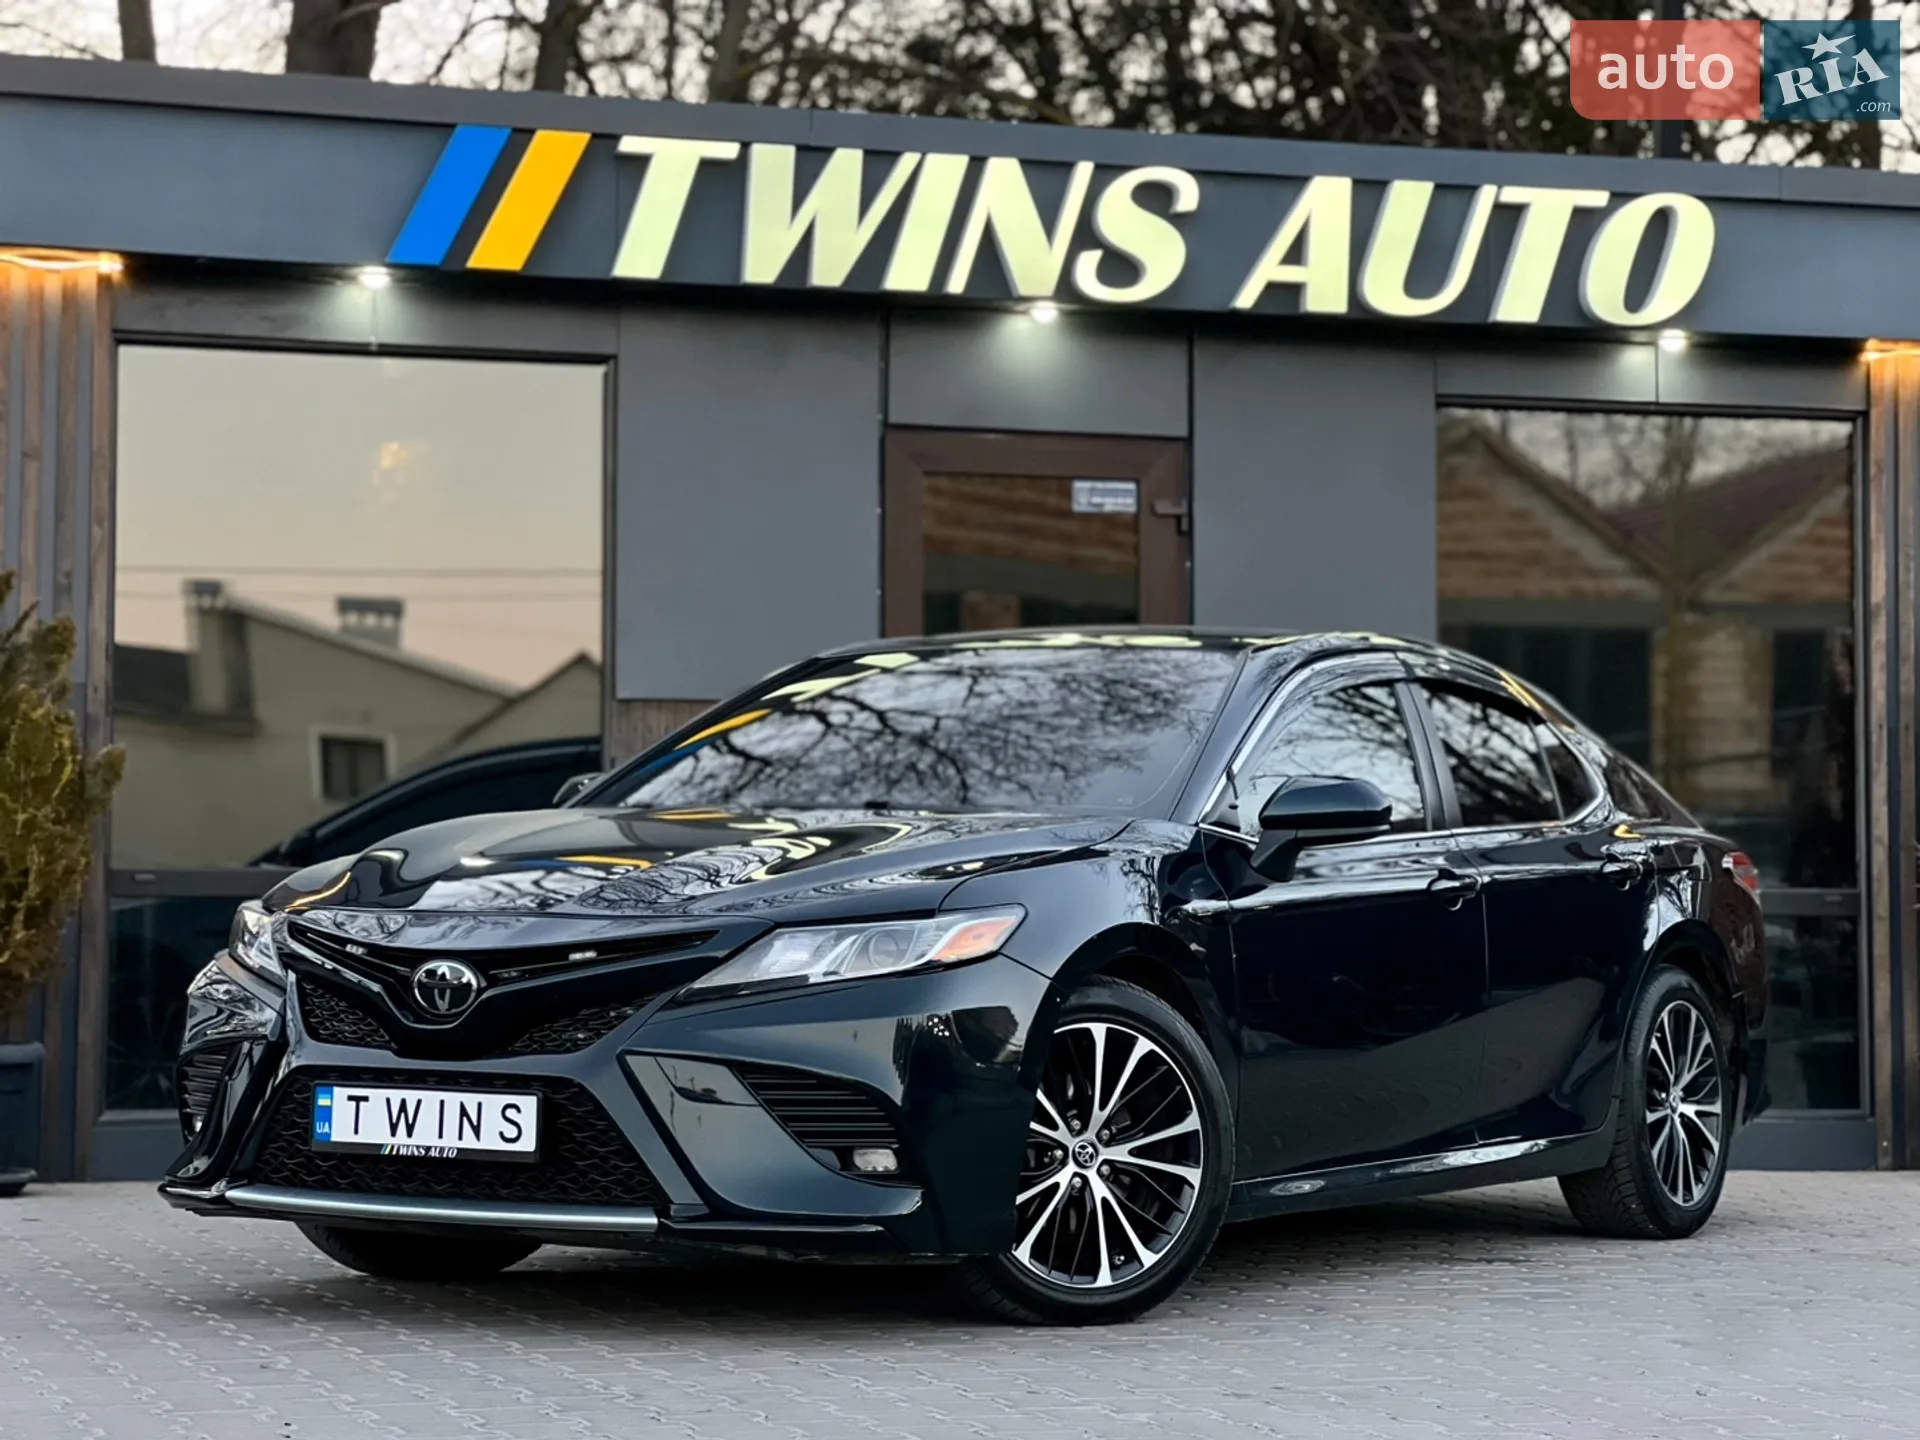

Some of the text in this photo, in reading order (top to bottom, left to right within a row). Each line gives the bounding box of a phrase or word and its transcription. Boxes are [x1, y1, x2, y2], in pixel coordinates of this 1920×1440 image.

[610, 135, 1716, 327] TWINS AUTO
[316, 1121, 330, 1134] UA
[346, 1095, 523, 1144] TWINS
[391, 1144, 458, 1159] TWINS AUTO
